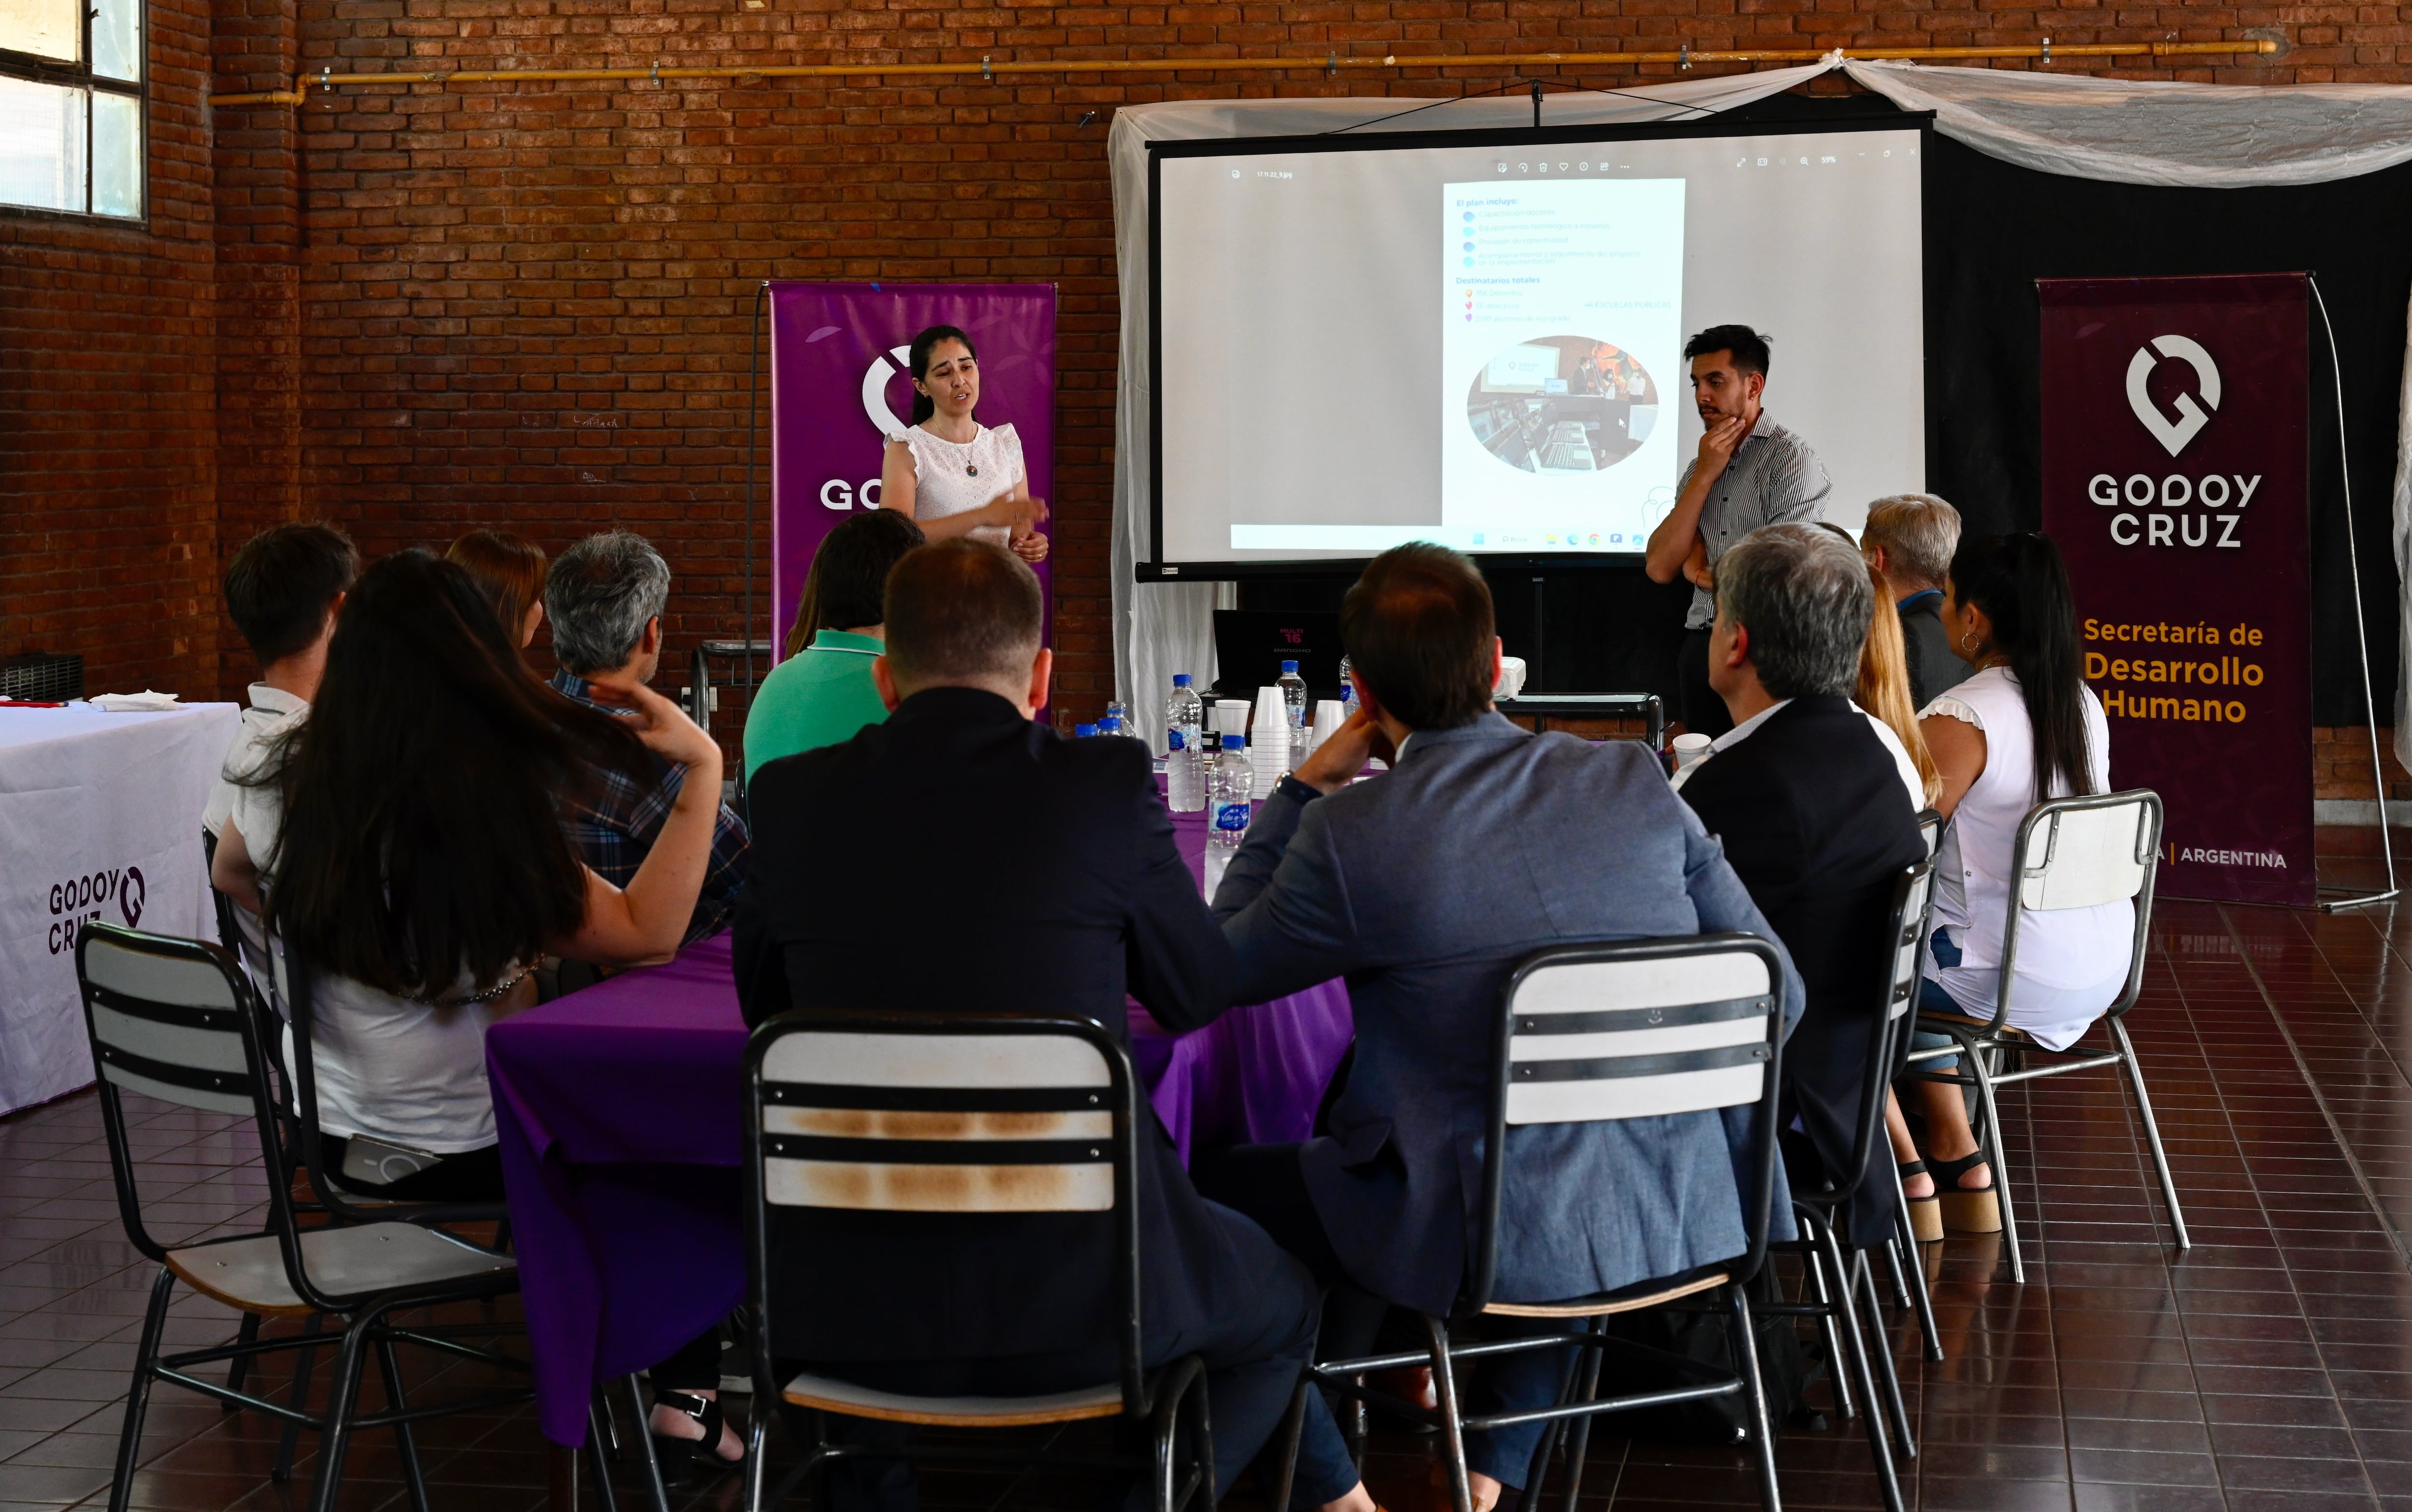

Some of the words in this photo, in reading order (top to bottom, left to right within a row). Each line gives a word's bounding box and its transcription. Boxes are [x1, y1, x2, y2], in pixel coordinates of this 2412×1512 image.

[1466, 199, 1484, 208] plan
[1486, 198, 1519, 206] incluye:
[1609, 250, 1641, 259] proyecto
[1456, 276, 1510, 285] Destinatarios
[2088, 474, 2262, 507] GODOY
[2110, 513, 2241, 548] CRUZ
[1285, 634, 1302, 643] 16
[2084, 618, 2220, 644] Secretaría
[2230, 623, 2263, 646] de
[2085, 652, 2264, 687] Desarrollo
[2103, 690, 2246, 723] Humano
[2180, 847, 2287, 868] ARGENTINA
[50, 869, 120, 915] GODOY
[49, 911, 101, 955] CR
